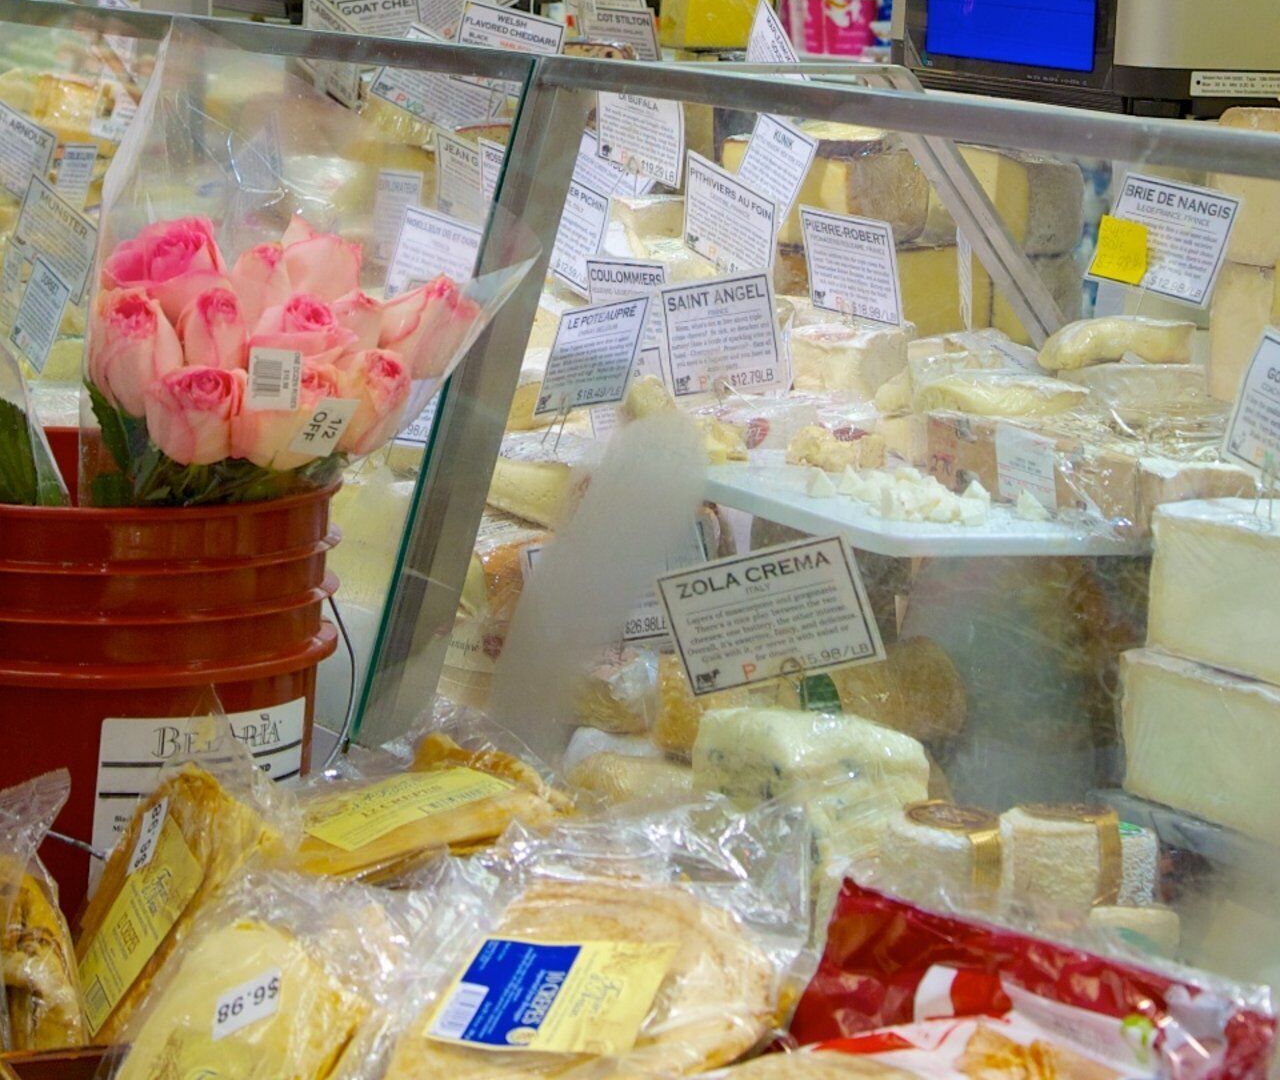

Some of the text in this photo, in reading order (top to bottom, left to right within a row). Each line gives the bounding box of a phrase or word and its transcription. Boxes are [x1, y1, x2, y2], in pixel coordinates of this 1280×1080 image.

[465, 16, 508, 35] FLAVORED
[509, 29, 557, 48] CHEDDARS
[496, 14, 528, 28] WELSH
[617, 14, 650, 26] STILTON
[630, 95, 658, 111] BUFALA
[443, 141, 470, 163] JEAN
[690, 167, 772, 220] PITHIVIERS AU FOIN
[1125, 184, 1233, 219] BRIE DE NANGIS
[40, 191, 88, 239] MUNSTER
[590, 268, 663, 285] COULOMMIERS
[667, 284, 765, 312] SAINT ANGEL
[567, 318, 580, 330] LE
[303, 411, 328, 442] OFF
[676, 551, 830, 600] ZOLA CREMA
[742, 664, 756, 680] P
[217, 976, 280, 1025] $6.98
